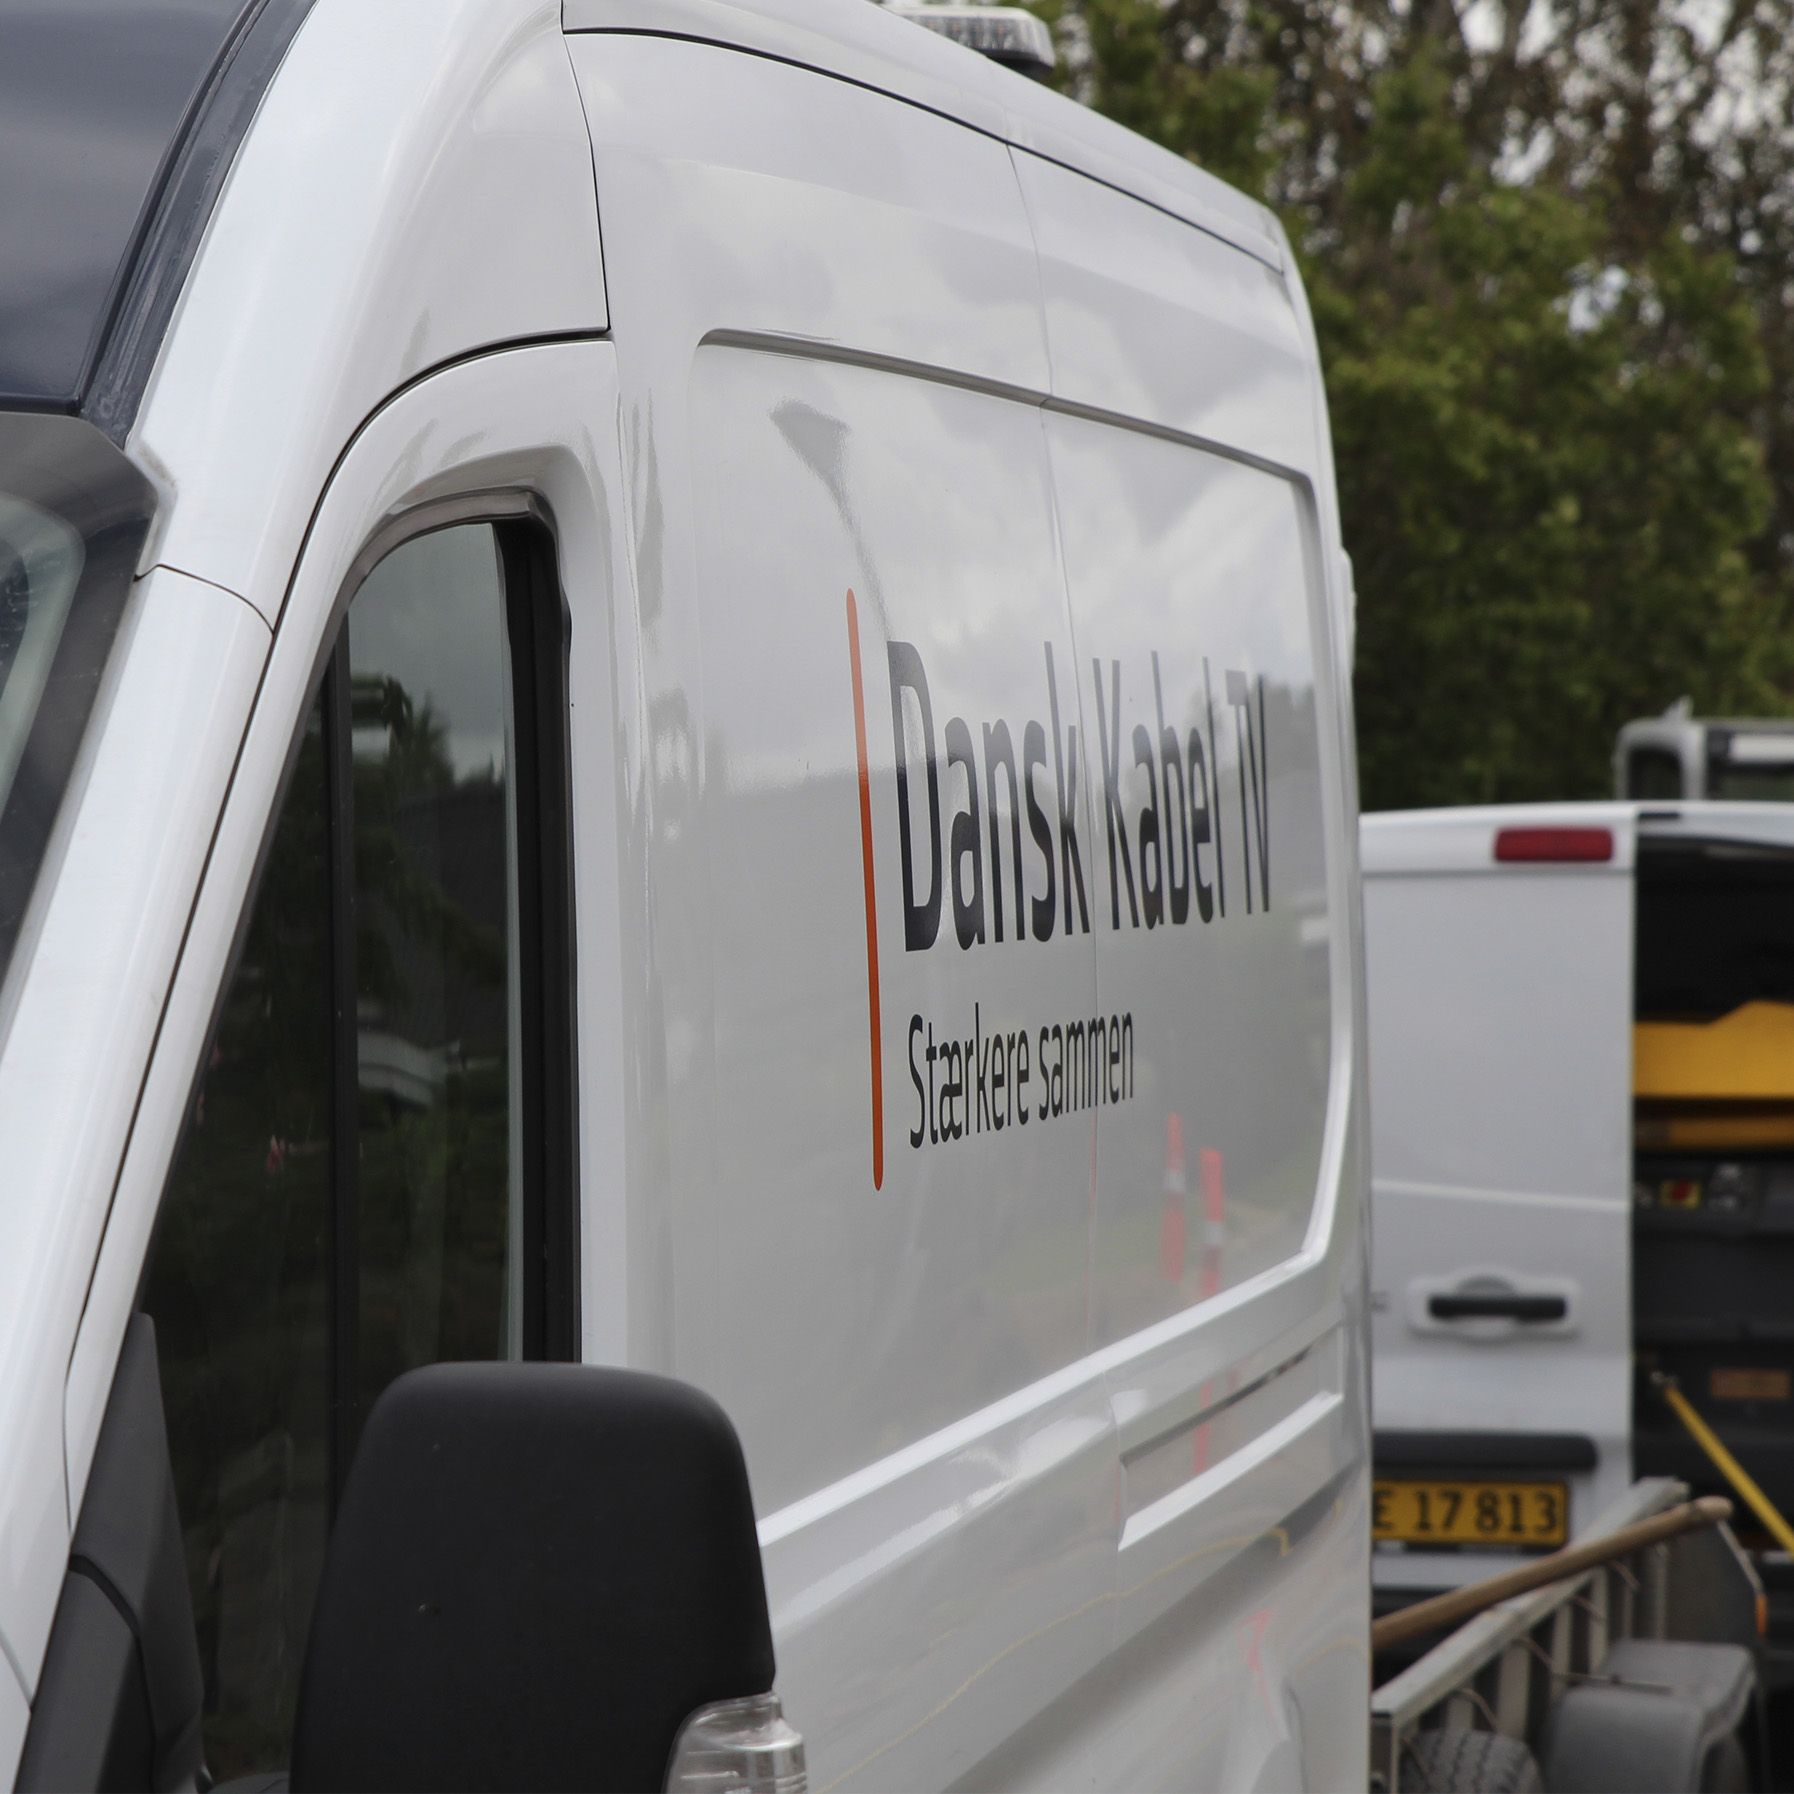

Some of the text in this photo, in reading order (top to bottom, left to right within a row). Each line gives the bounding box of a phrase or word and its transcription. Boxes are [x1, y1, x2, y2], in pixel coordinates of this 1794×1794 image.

[887, 640, 1270, 952] Dansk Kabel TV
[909, 1002, 1134, 1150] Stærkere sammen
[1416, 1490, 1462, 1532] 17
[1474, 1490, 1558, 1534] 813
